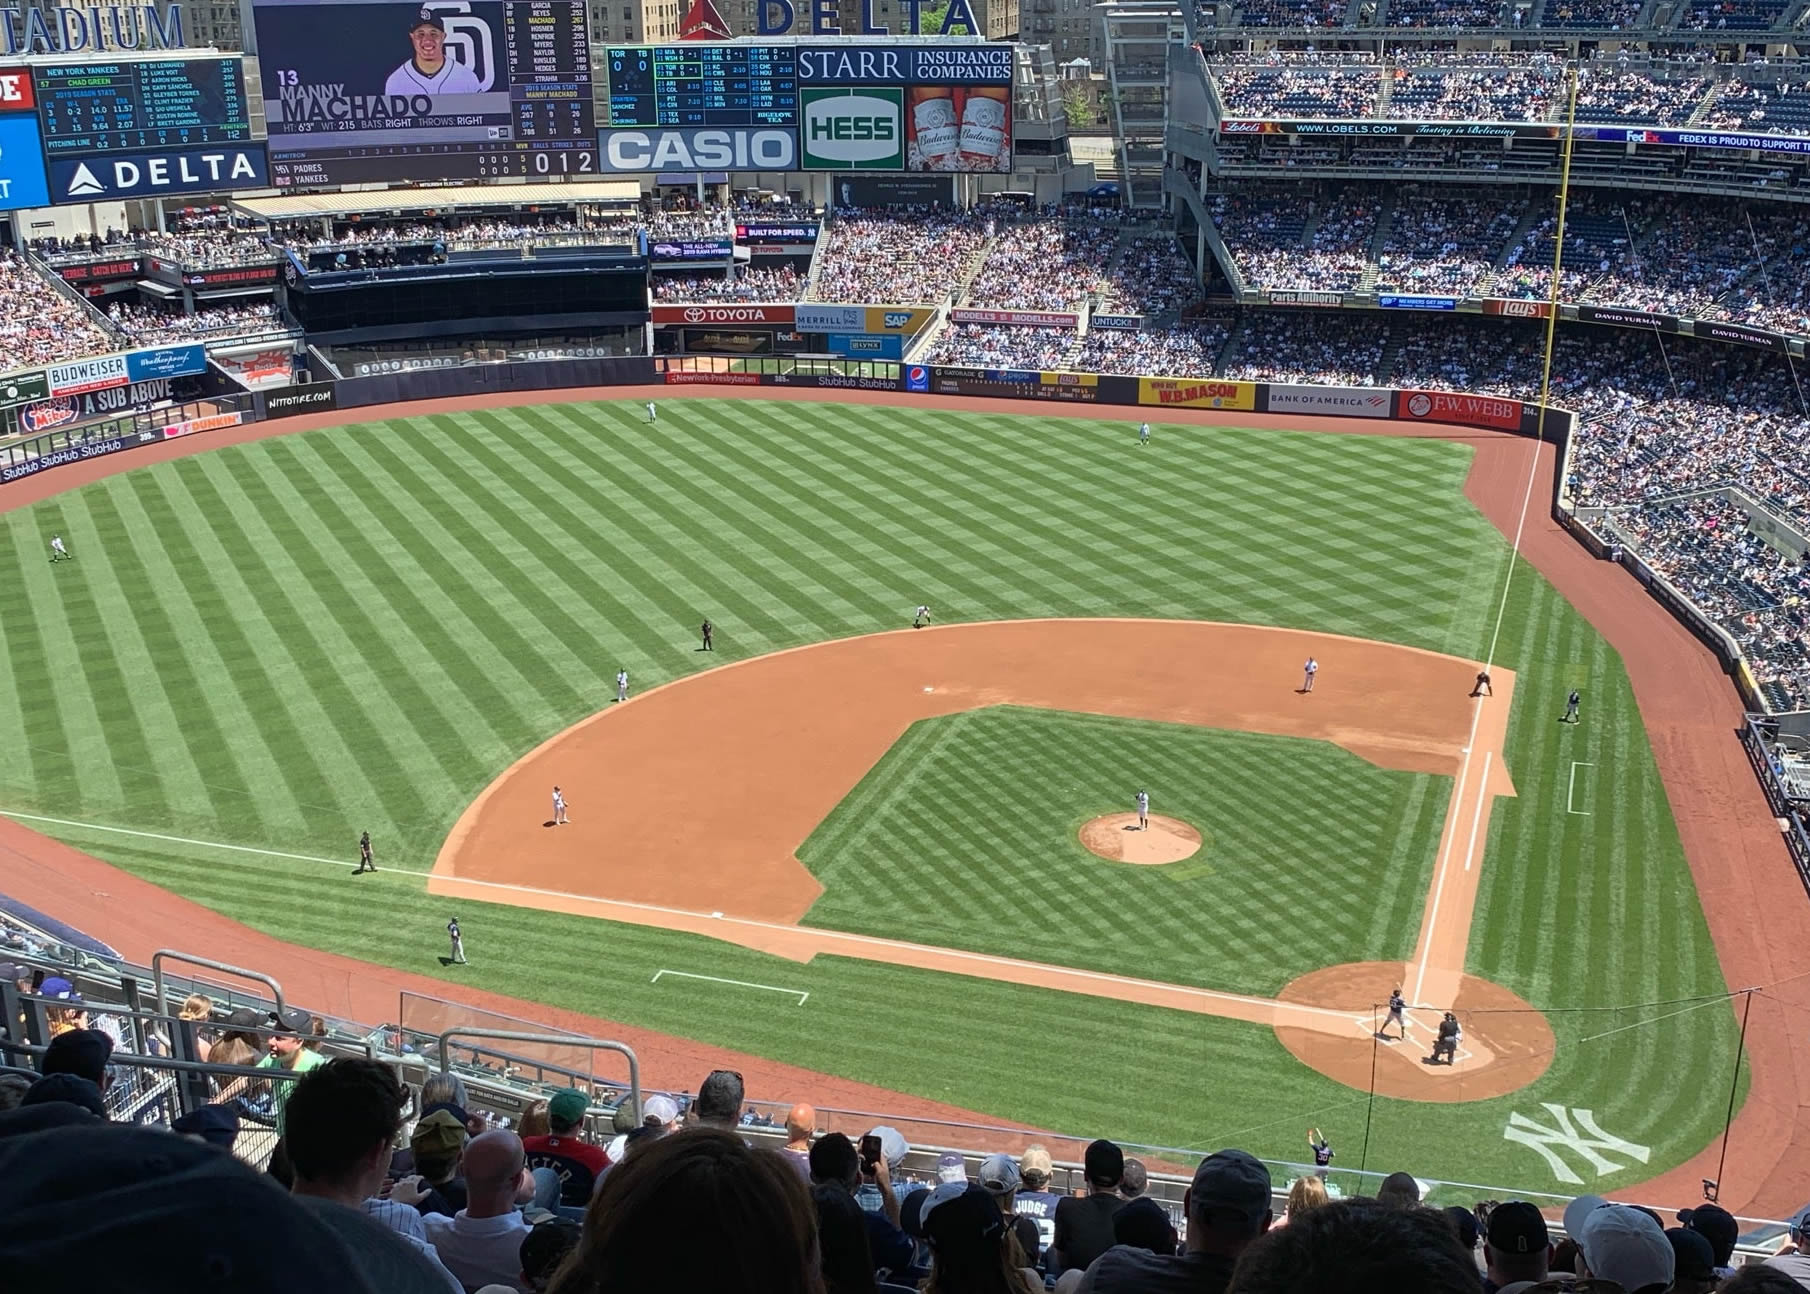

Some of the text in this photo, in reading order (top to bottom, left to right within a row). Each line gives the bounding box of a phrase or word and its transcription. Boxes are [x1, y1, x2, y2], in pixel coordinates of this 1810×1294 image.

[758, 0, 981, 37] DELTA
[614, 61, 621, 71] 0
[639, 61, 647, 71] 0
[799, 51, 905, 78] STARR
[918, 51, 1011, 65] INSURANCE
[46, 66, 120, 76] NEW YORK YANKEES
[277, 70, 299, 86] 13
[917, 66, 1011, 79] COMPANIES
[280, 83, 344, 100] MANNY
[91, 106, 107, 114] 14.0
[113, 105, 133, 113] 11.57
[281, 95, 432, 122] MACHADO
[72, 124, 82, 132] 15
[117, 121, 133, 129] 2.07
[283, 124, 297, 132] HT:
[321, 122, 337, 130] WT:
[339, 121, 355, 130] 215
[361, 120, 385, 128] BATS:
[385, 118, 412, 128] RIGHT
[418, 117, 455, 127] THROWS:
[457, 116, 483, 126] RIGHT
[811, 117, 894, 140] HESS
[1224, 121, 1260, 132] Lobel's
[1296, 125, 1397, 133] WWW.LOBELS.COM
[1416, 125, 1453, 136] Tasting
[1467, 126, 1516, 137] Believing
[1627, 130, 1660, 142] FedEx
[1679, 135, 1707, 143] FEDEX
[1709, 136, 1717, 144] IS
[1720, 137, 1749, 146] PROUD
[1750, 139, 1760, 147] TO
[1762, 139, 1801, 150] SUPPORT
[608, 130, 793, 169] CASIO
[114, 153, 256, 188] DELTA
[293, 164, 322, 173] PADRES
[479, 156, 485, 164] 0
[535, 152, 592, 173] 0 1 2
[295, 174, 328, 184] YANKEES
[480, 167, 486, 175] 0
[503, 166, 509, 174] 0
[783, 228, 806, 236] SPEED.
[1271, 292, 1296, 301] Parts
[1297, 292, 1342, 304] Authority
[707, 309, 765, 321] TOYOTA
[956, 311, 995, 320] MODELL'S
[1503, 300, 1537, 316] Lay's
[797, 317, 841, 325] MERRILL
[885, 315, 908, 326] SAP
[1012, 313, 1073, 324] MODELLS.com
[1594, 312, 1662, 326] DAVID YURMAN
[777, 332, 803, 342] FedEx
[1712, 329, 1772, 346] DAVID YURMAN
[52, 359, 124, 383] BUDWEISER
[944, 369, 975, 377] GATORADE
[819, 376, 896, 389] StubHub StubHub
[85, 394, 95, 414] A
[98, 387, 126, 411] SUB
[130, 379, 174, 405] ABOVE
[269, 391, 331, 409] NITTOTIRE.COM
[1271, 395, 1299, 403] BANK
[1317, 396, 1363, 406] AMERICA
[1434, 396, 1462, 411] F.W.
[1466, 399, 1513, 418] WEBB
[3, 440, 121, 480] StubHub StubHub StubHub
[1015, 1200, 1048, 1217] JUDGE
